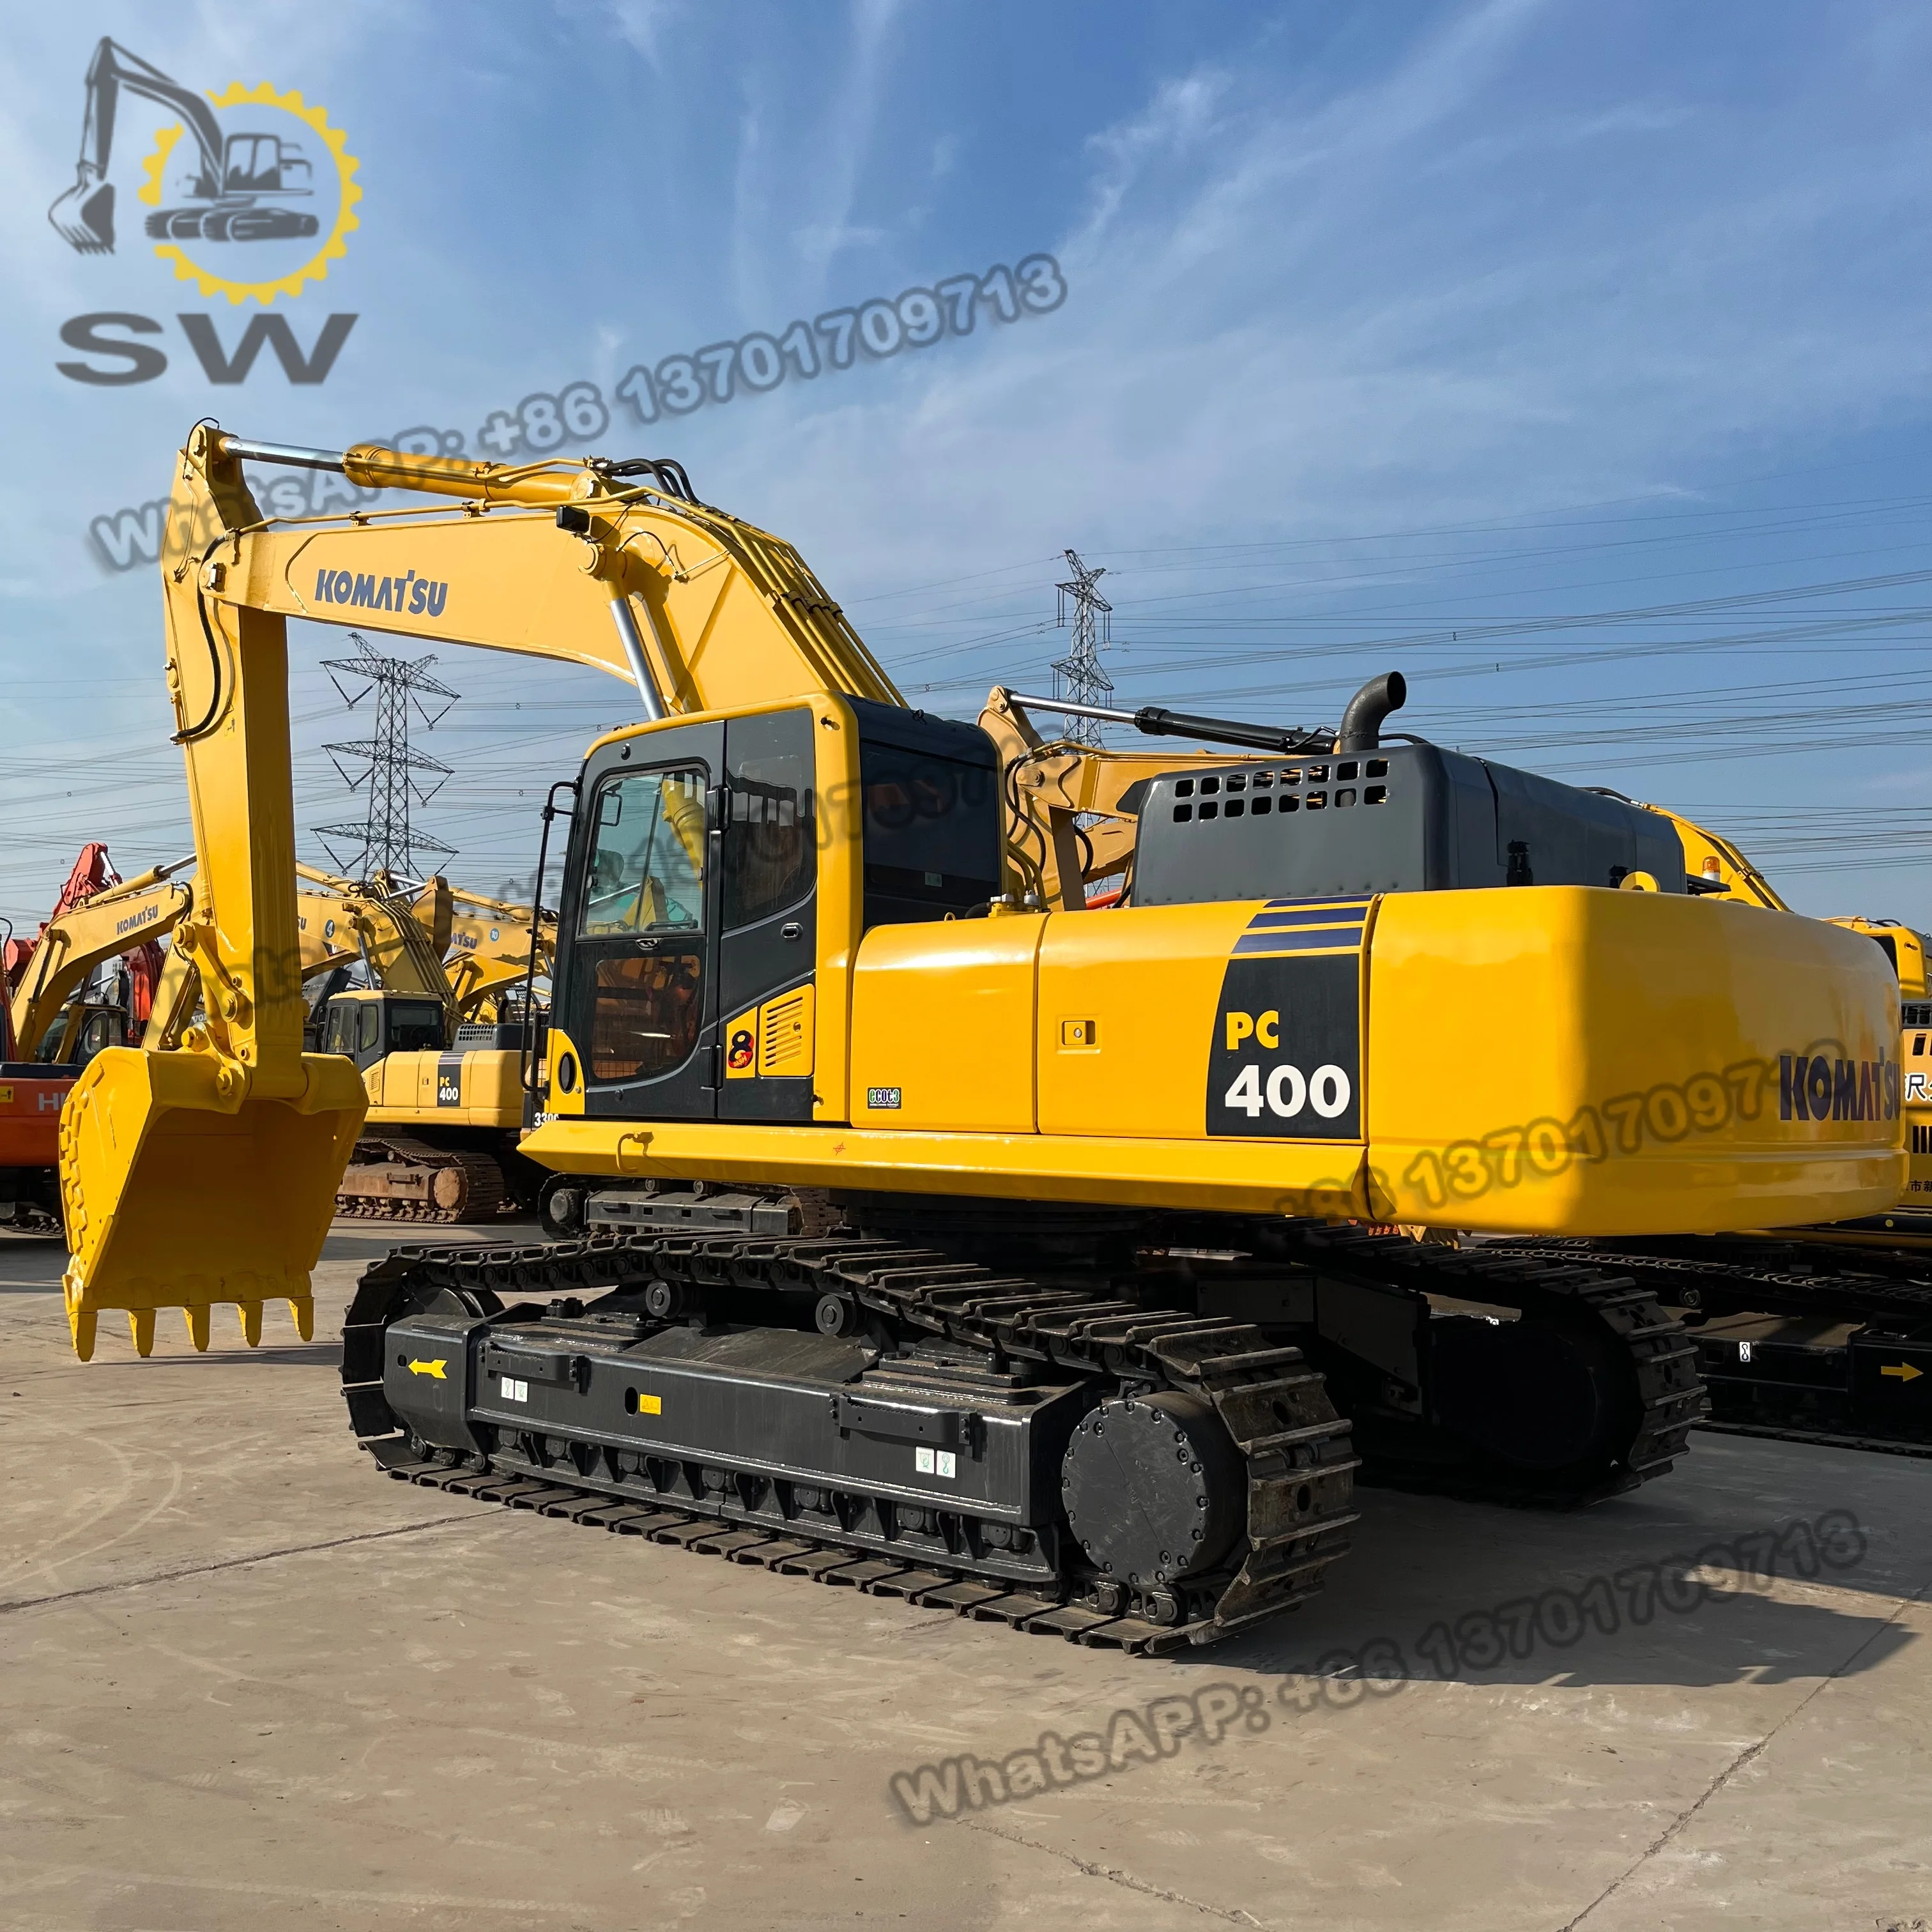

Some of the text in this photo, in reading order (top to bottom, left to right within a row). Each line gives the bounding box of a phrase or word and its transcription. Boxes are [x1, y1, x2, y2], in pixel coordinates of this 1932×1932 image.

[315, 569, 448, 617] KOMATSU
[117, 905, 158, 935] KOMATSU
[326, 922, 334, 937] 4
[451, 932, 477, 949] ATSU
[1227, 1010, 1279, 1050] PC
[728, 1029, 754, 1068] 8
[440, 1077, 450, 1087] PC
[440, 1087, 459, 1101] 400
[869, 1089, 900, 1103] ecot3
[1225, 1064, 1350, 1118] 400
[1779, 1046, 1901, 1121] KOMATSU
